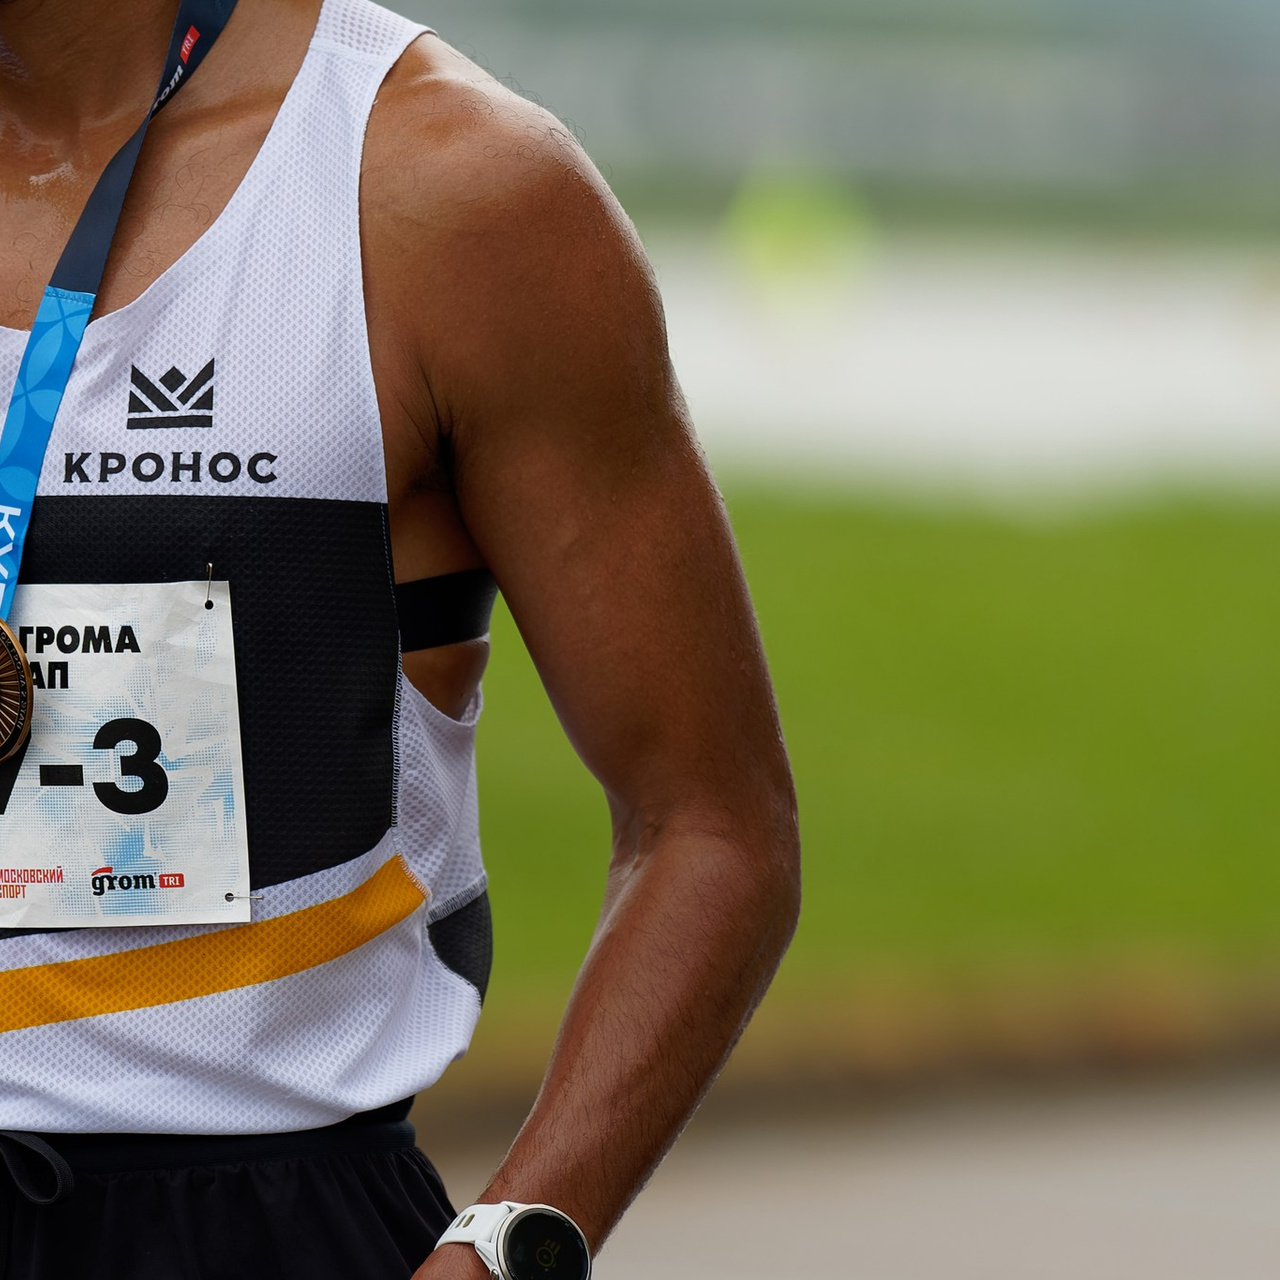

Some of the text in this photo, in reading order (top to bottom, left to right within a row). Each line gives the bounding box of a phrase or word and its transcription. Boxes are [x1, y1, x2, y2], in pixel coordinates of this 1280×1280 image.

[151, 65, 183, 111] rom
[62, 451, 279, 484] КРОНОС
[19, 625, 141, 654] ГРОМА
[91, 872, 180, 896] grom TRI
